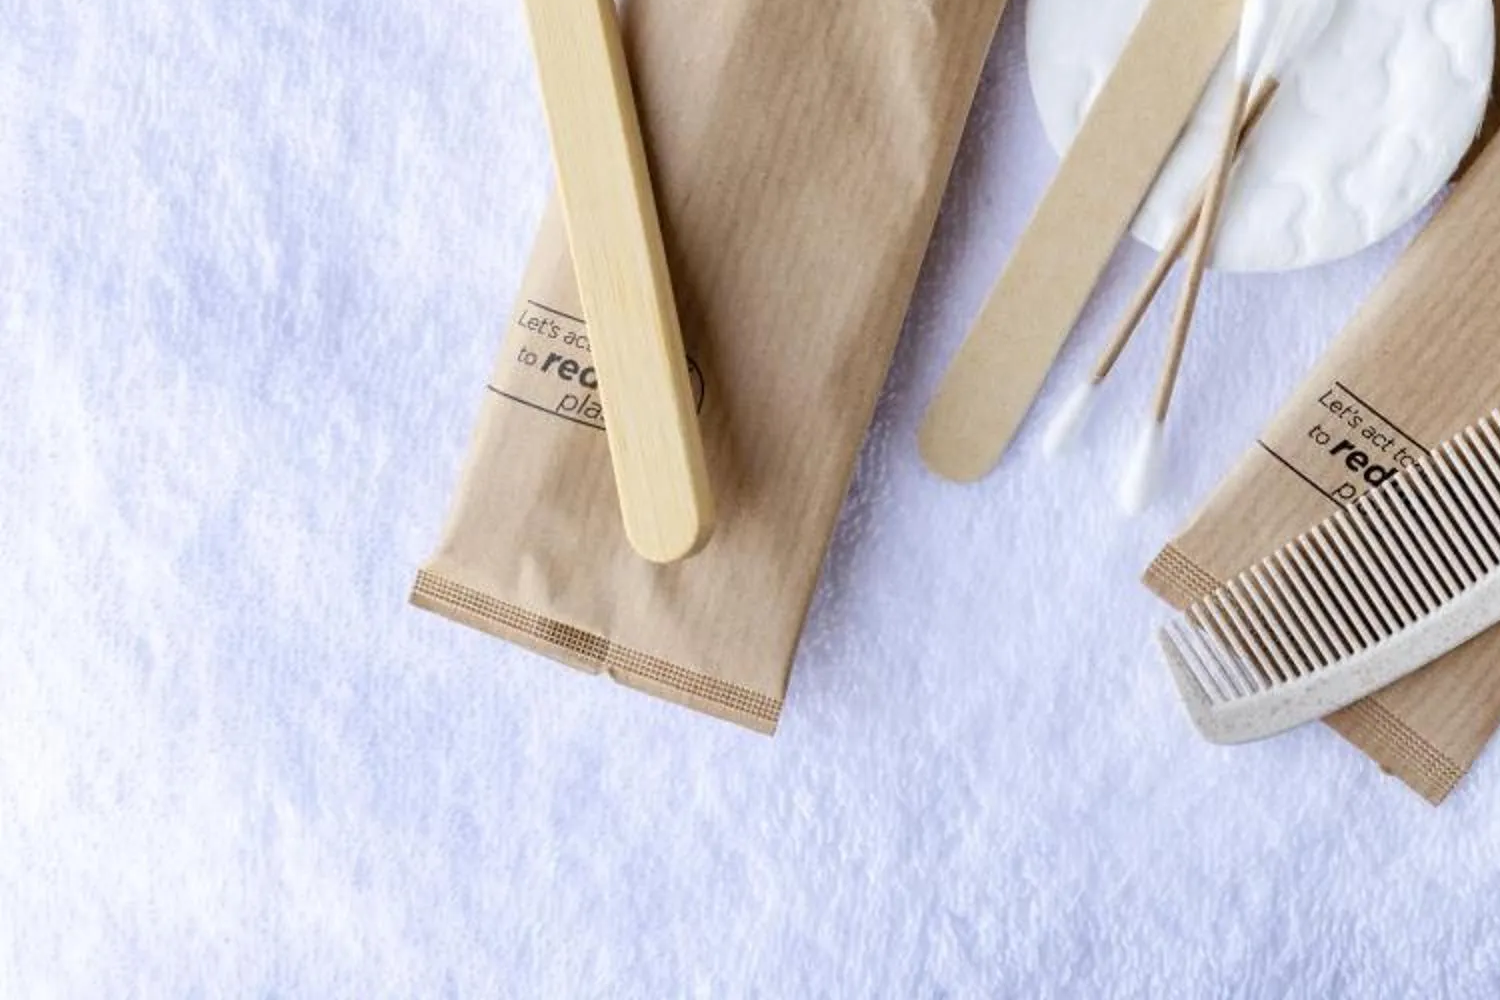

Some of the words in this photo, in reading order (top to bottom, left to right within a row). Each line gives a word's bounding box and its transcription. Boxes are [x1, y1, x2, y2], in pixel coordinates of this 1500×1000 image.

[516, 345, 538, 367] to
[517, 310, 561, 340] Let's
[563, 331, 592, 353] ac
[1317, 388, 1364, 429] Let's
[1361, 425, 1395, 452] act
[1307, 423, 1331, 446] to
[1329, 439, 1402, 491] red
